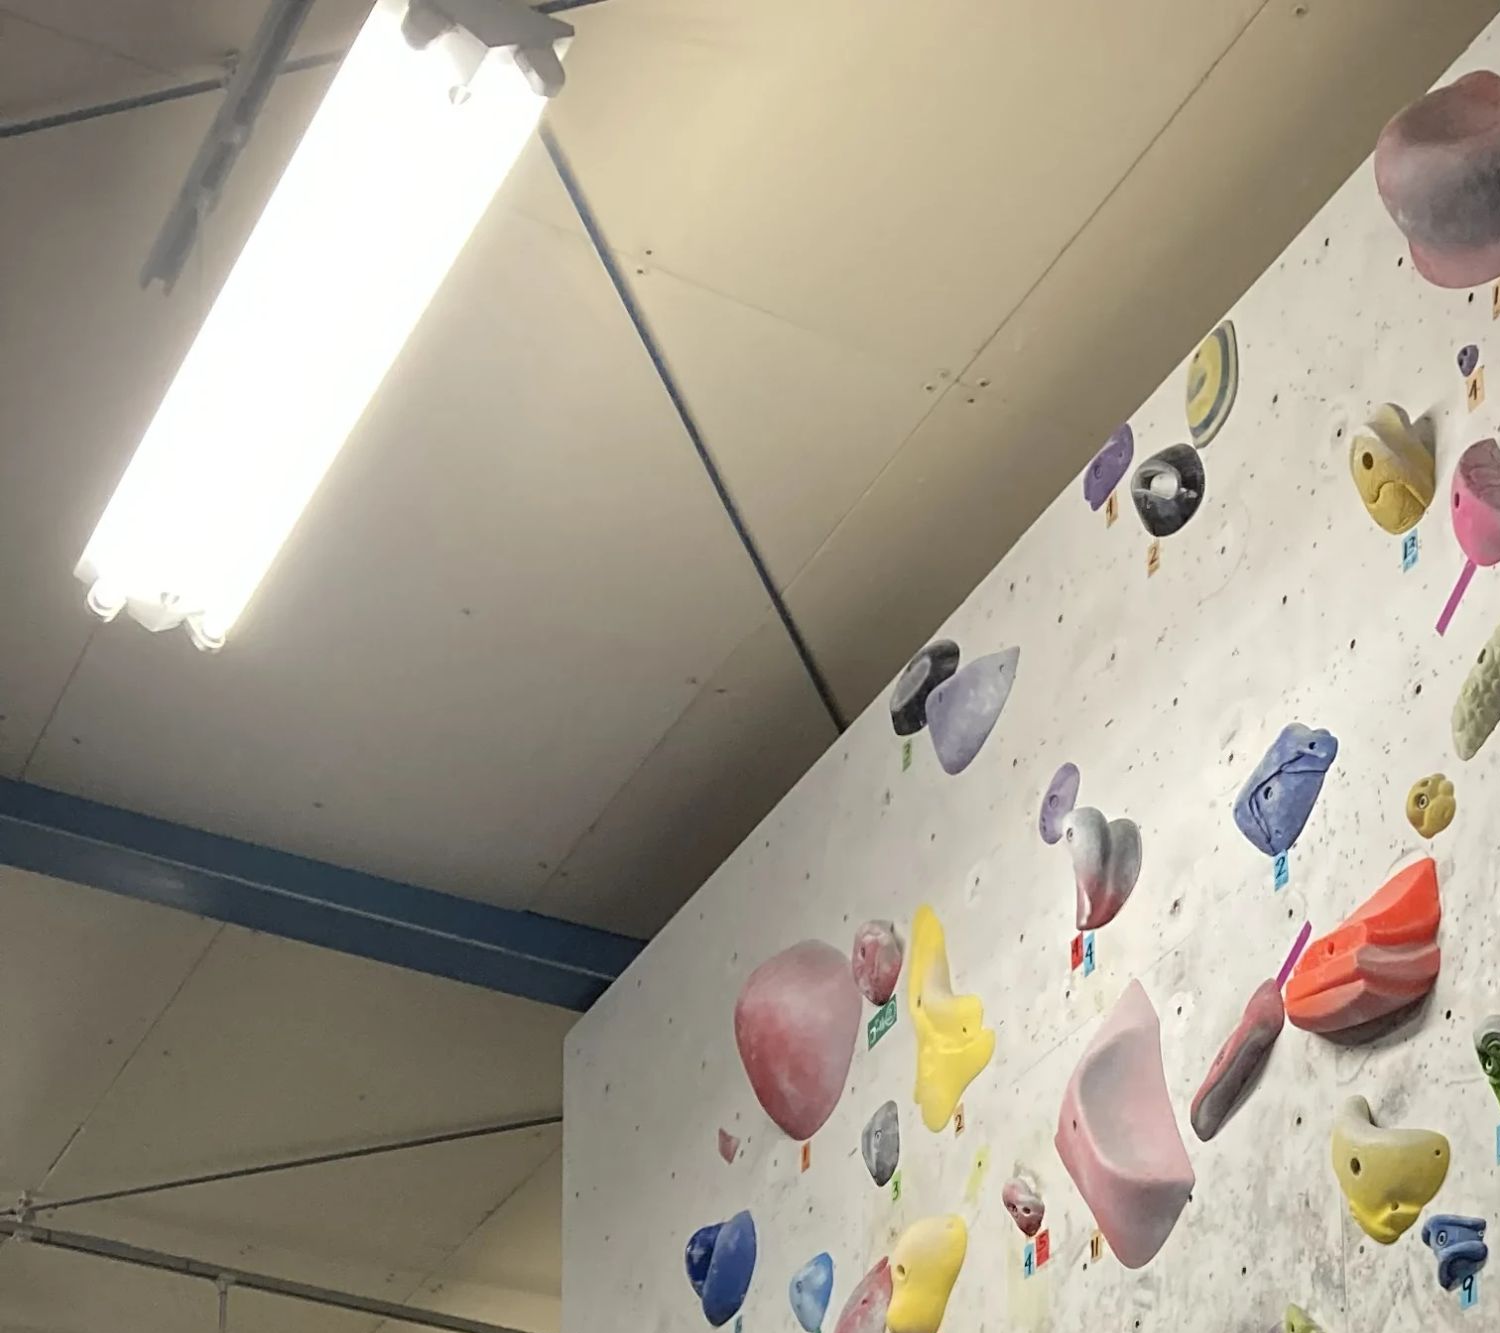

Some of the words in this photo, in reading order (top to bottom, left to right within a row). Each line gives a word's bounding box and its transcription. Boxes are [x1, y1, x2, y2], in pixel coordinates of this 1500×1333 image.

[1150, 547, 1158, 565] 2
[1403, 534, 1415, 560] 13
[1275, 856, 1286, 880] 2
[1085, 939, 1093, 964] 4
[955, 1113, 962, 1132] 2
[893, 1180, 899, 1201] 3
[1091, 1237, 1098, 1258] 11
[1025, 1251, 1032, 1273] 4
[1462, 1274, 1473, 1303] 9
